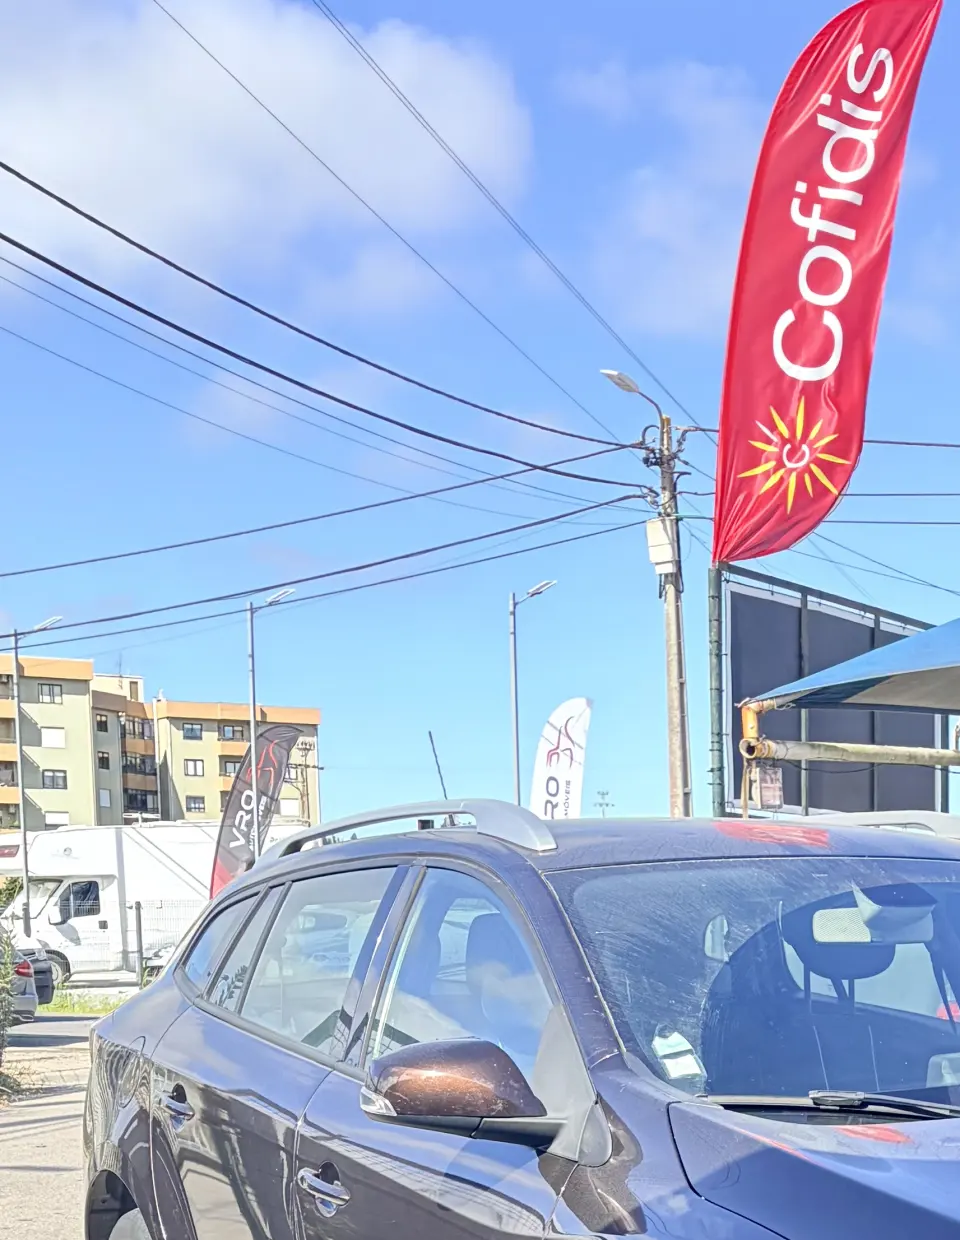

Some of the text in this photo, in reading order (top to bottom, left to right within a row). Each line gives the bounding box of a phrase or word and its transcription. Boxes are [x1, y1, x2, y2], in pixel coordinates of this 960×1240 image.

[773, 43, 894, 382] Cofidis
[229, 789, 255, 848] VRO
[545, 776, 559, 819] RO
